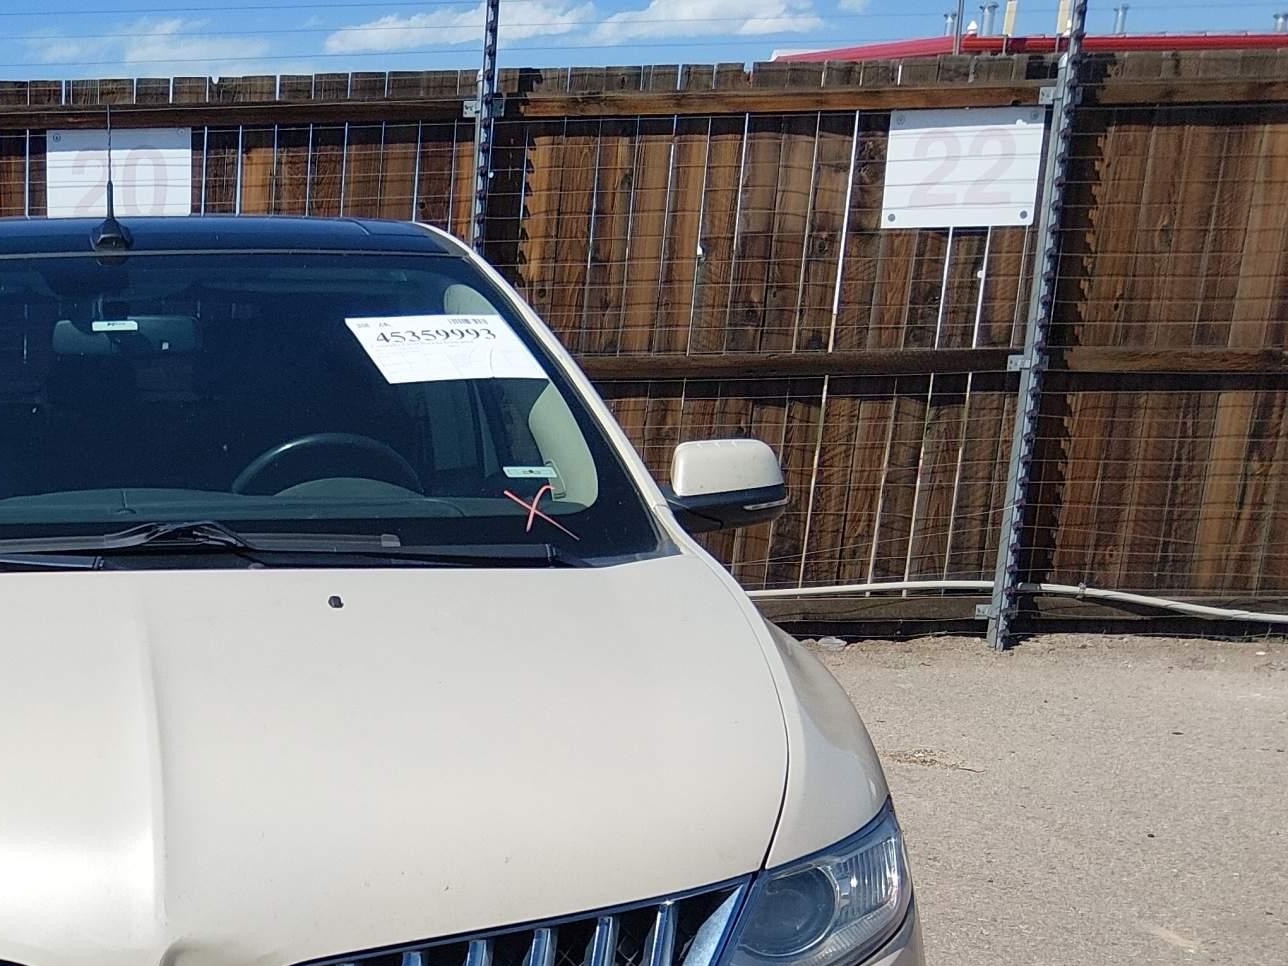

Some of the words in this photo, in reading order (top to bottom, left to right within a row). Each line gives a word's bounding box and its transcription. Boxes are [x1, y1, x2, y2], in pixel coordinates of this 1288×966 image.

[71, 145, 169, 217] 20
[907, 128, 1016, 208] 22
[376, 328, 497, 343] 45359993
